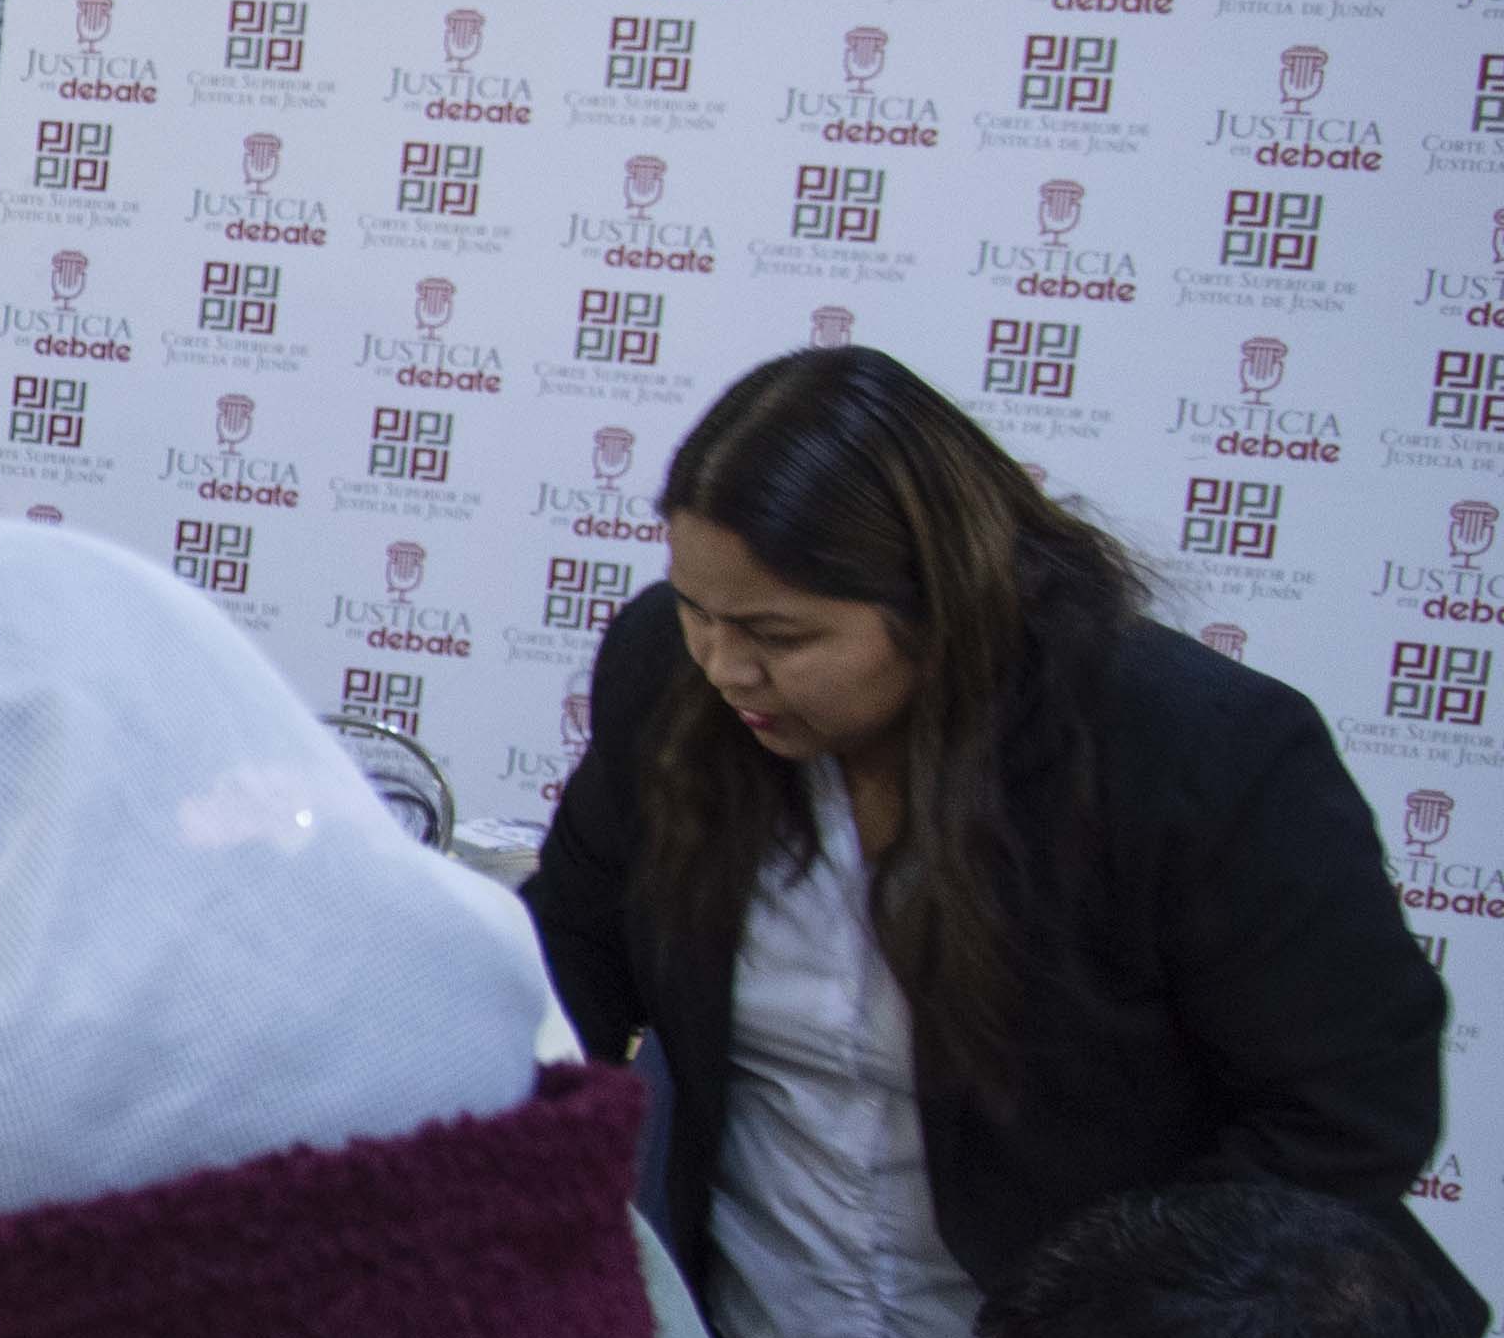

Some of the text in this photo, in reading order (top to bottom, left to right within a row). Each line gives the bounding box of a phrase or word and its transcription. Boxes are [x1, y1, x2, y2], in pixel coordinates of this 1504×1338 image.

[19, 48, 158, 83] JUSTICIA
[59, 76, 158, 104] debate
[382, 67, 533, 103] JUSTICIA
[425, 96, 532, 125] debate
[776, 87, 940, 124] JUSTICIA
[822, 117, 939, 148] debate
[1205, 108, 1383, 147] JUSTICIA
[1255, 140, 1382, 172] debate
[184, 188, 327, 223] JUSTICIA
[225, 218, 327, 247] debate
[560, 213, 716, 249] JUSTICIA
[604, 243, 715, 274] debate
[968, 239, 1138, 277] JUSTICIA
[1016, 271, 1137, 303] debate
[34, 333, 132, 362] debate
[354, 332, 503, 370] JUSTICIA
[396, 363, 502, 394] debate
[1166, 396, 1342, 438] JUSTICIA
[1215, 430, 1341, 464] debate
[158, 447, 300, 485] JUSTICIA
[198, 478, 299, 508] debate
[573, 513, 664, 545] debat
[325, 594, 472, 635] JUSTICIA
[367, 626, 472, 658] debate
[1395, 883, 1504, 920] ebate
